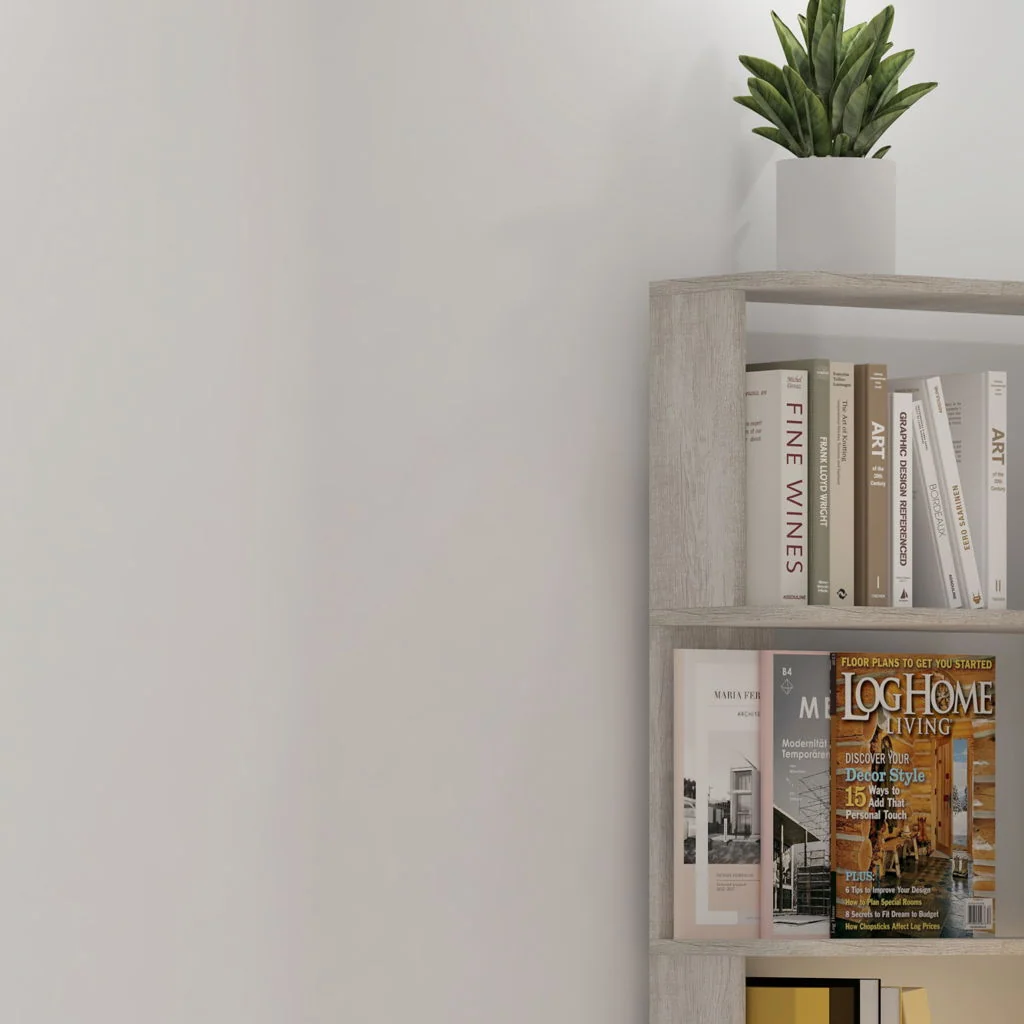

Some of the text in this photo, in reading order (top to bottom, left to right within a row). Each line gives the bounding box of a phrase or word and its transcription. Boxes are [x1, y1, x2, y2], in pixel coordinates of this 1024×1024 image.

[786, 403, 803, 465] FINE
[871, 421, 885, 460] ART
[992, 427, 1005, 465] ART
[840, 435, 848, 462] Knitting
[820, 436, 828, 527] FRANK LLOYD WRIGHT
[929, 484, 947, 538] BORDEAUX
[951, 485, 971, 551] EERO SAARINEN
[786, 480, 803, 573] WINES
[842, 657, 869, 667] FLOOR
[872, 658, 899, 667] PLANS
[903, 658, 913, 668] TO
[916, 659, 932, 668] GET
[935, 659, 952, 669] YOU
[955, 660, 992, 669] STARTED
[714, 691, 742, 700] MARIA
[887, 718, 950, 735] LIVING
[782, 739, 827, 748] Modernität
[846, 753, 909, 764] DISCOVER YOUR
[845, 768, 925, 786] Decor Style
[845, 786, 867, 807] 15
[868, 785, 900, 796] Ways to
[868, 798, 905, 807] Add That
[846, 810, 907, 820] Personal Touch
[845, 872, 875, 881] PLUS:
[851, 887, 863, 895] Tips
[873, 887, 895, 895] Improve
[912, 886, 931, 895] Design
[881, 899, 901, 907] Special
[919, 911, 939, 919] Budget
[859, 923, 890, 931] Chopsticks
[910, 923, 921, 931] Log
